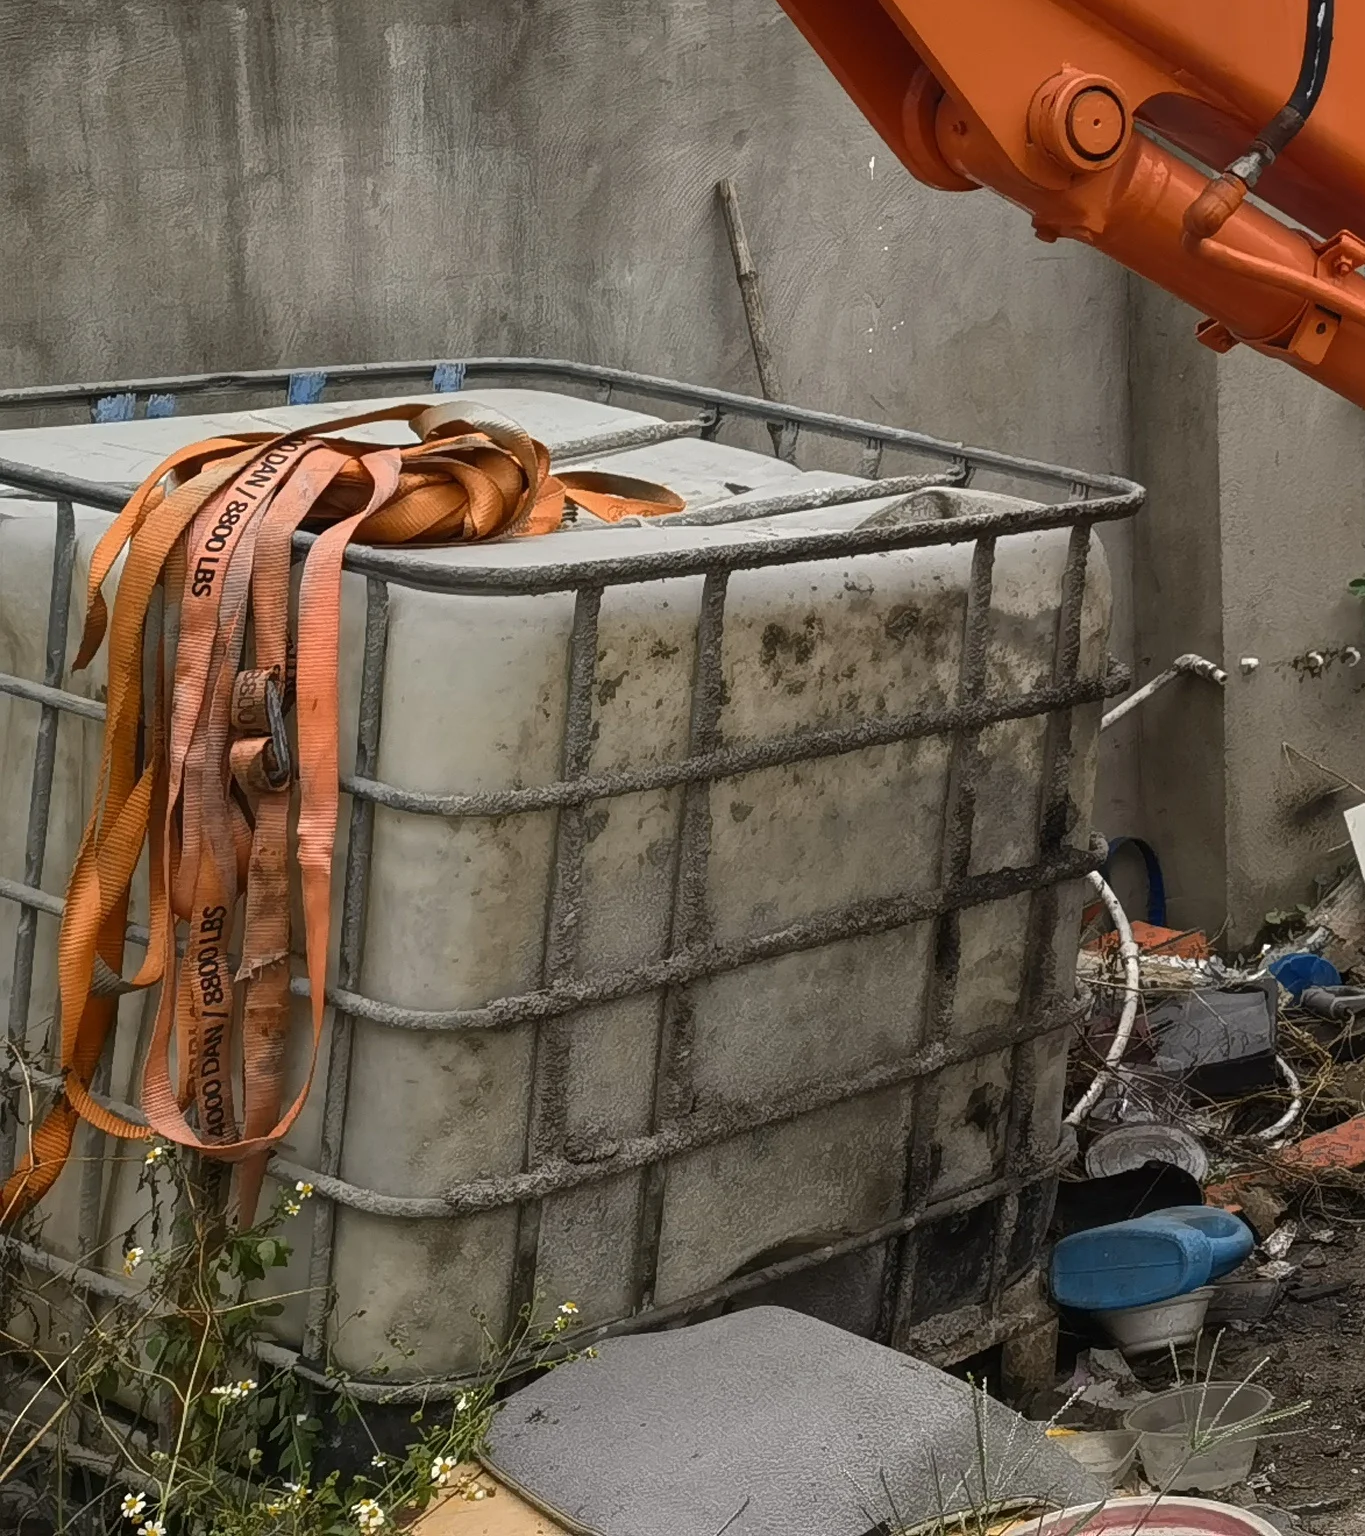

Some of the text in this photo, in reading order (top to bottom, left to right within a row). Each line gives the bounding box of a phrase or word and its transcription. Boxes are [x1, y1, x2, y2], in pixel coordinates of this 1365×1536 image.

[244, 452, 290, 488] DAN
[205, 500, 248, 552] 8800
[191, 556, 219, 597] LBS
[199, 905, 227, 944] LBS
[198, 946, 224, 1006] 8800
[201, 1023, 224, 1078] DAN
